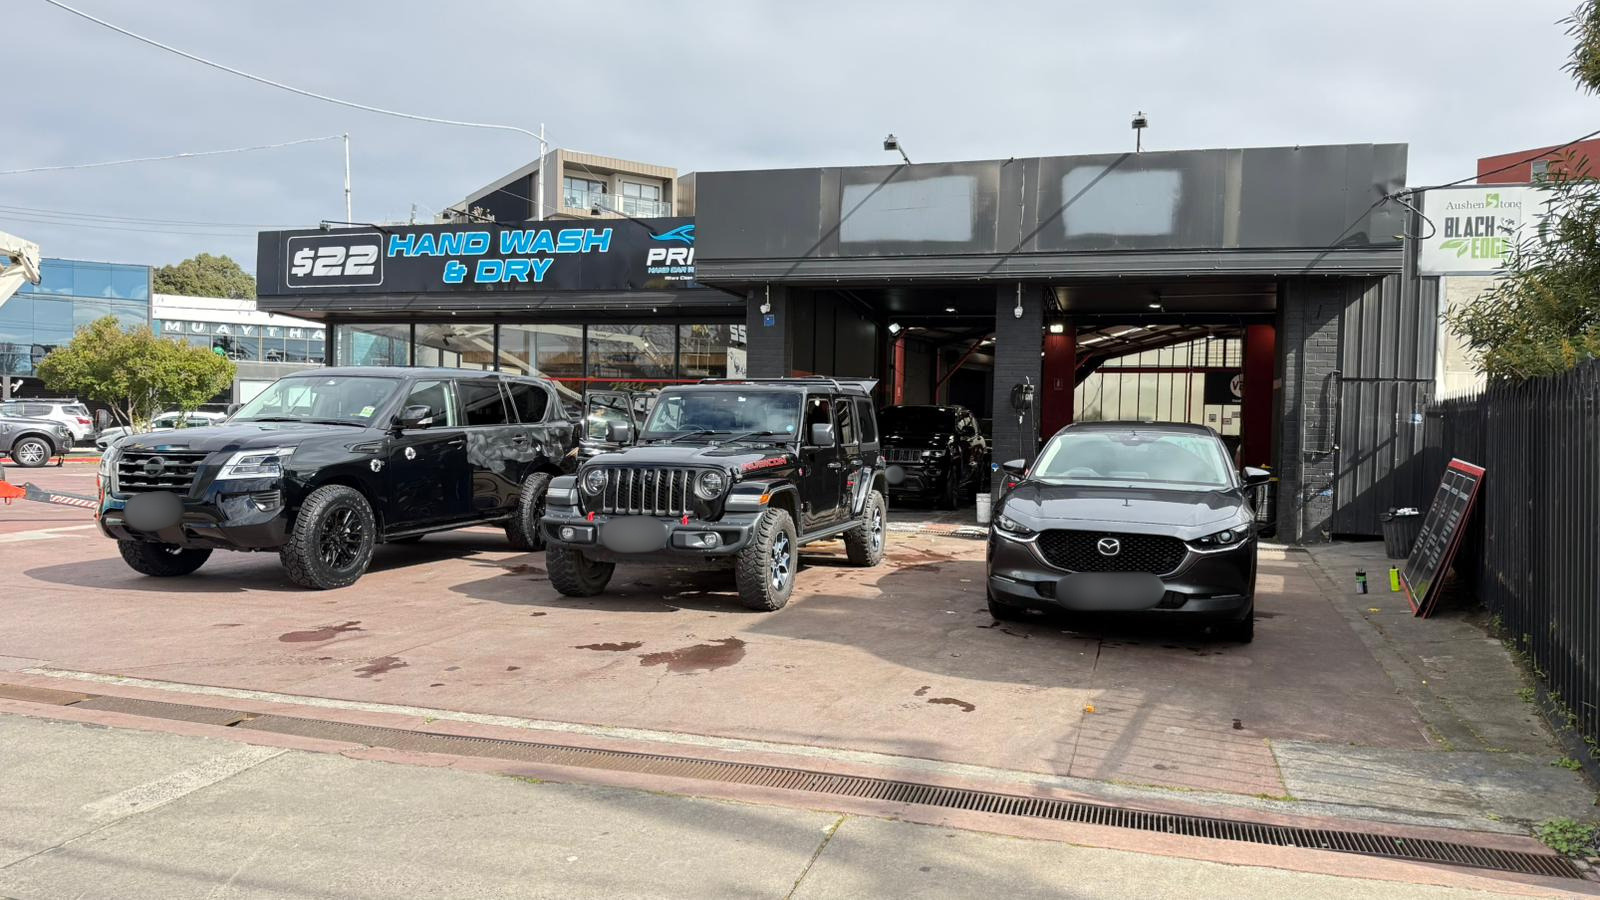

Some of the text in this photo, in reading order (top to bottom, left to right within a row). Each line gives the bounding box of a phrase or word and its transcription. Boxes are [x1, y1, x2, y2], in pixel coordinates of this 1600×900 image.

[387, 228, 613, 257] HAND WASH
[291, 245, 379, 277] $22
[443, 258, 554, 283] & DRY
[648, 266, 670, 274] HAND
